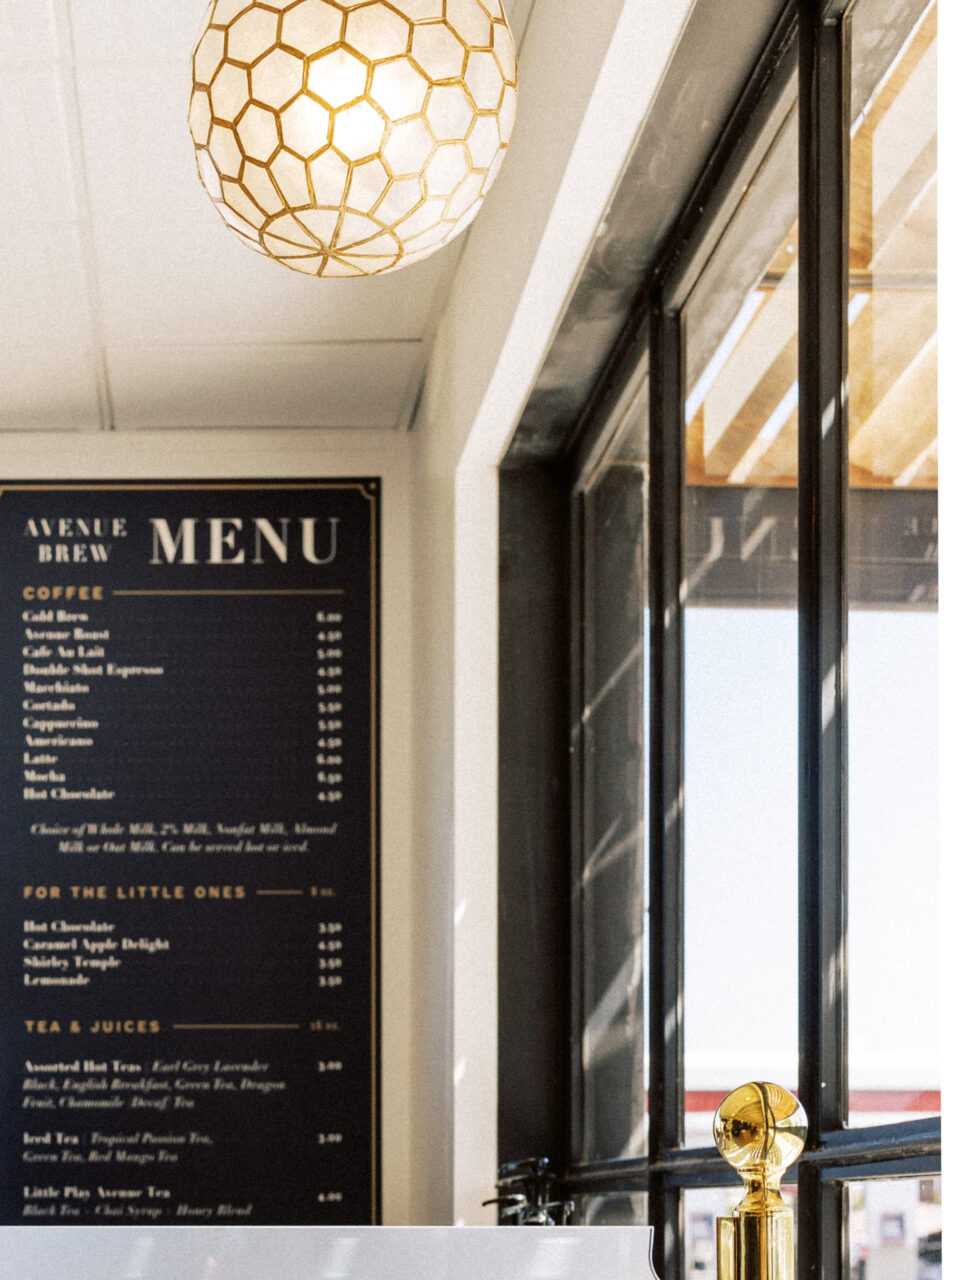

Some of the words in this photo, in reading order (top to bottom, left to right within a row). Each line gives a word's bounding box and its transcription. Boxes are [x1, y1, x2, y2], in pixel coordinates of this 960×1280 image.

[23, 518, 128, 538] AVENUE
[149, 518, 340, 565] MENU
[38, 543, 112, 563] BREW
[23, 586, 104, 601] COFFEE
[22, 609, 54, 622] Cold
[56, 610, 88, 622] Brew
[25, 628, 71, 640] Avenue
[74, 628, 109, 640] Roast
[57, 646, 76, 658] Au
[78, 645, 105, 658] Lait
[23, 663, 70, 675] Double
[72, 663, 103, 675] Shot
[106, 663, 164, 678] Espresso
[23, 681, 90, 694] Macchiato
[22, 699, 76, 711] Cortado
[22, 716, 99, 732] Cappuccino
[25, 735, 94, 747] Americano
[23, 752, 58, 764] Latte
[24, 770, 66, 782] Mocha
[23, 788, 47, 800] Hot
[50, 788, 115, 800] Chocolate
[59, 840, 84, 853] Milk
[23, 886, 61, 899] FOR
[70, 886, 107, 899] THE
[116, 886, 185, 899] LITTLE
[194, 886, 246, 899] ONES
[23, 920, 47, 932] Hot
[51, 920, 115, 932] Chocolate
[23, 938, 77, 950] Caramel
[82, 938, 119, 954] Apple
[122, 938, 169, 953] Delight
[23, 956, 69, 971] Shirley
[73, 956, 121, 971] Temple
[24, 973, 90, 986] Lemonade
[24, 1020, 61, 1033] TEA
[70, 1020, 81, 1033] &
[90, 1020, 161, 1033] JUICES
[25, 1061, 80, 1073] Assorted
[83, 1061, 108, 1073] Hot
[111, 1061, 142, 1073] Teas
[23, 1132, 51, 1145] Iced
[55, 1132, 80, 1144] Tea
[23, 1186, 61, 1199] Little
[97, 1187, 143, 1199] Avenue
[147, 1186, 171, 1199] Tea
